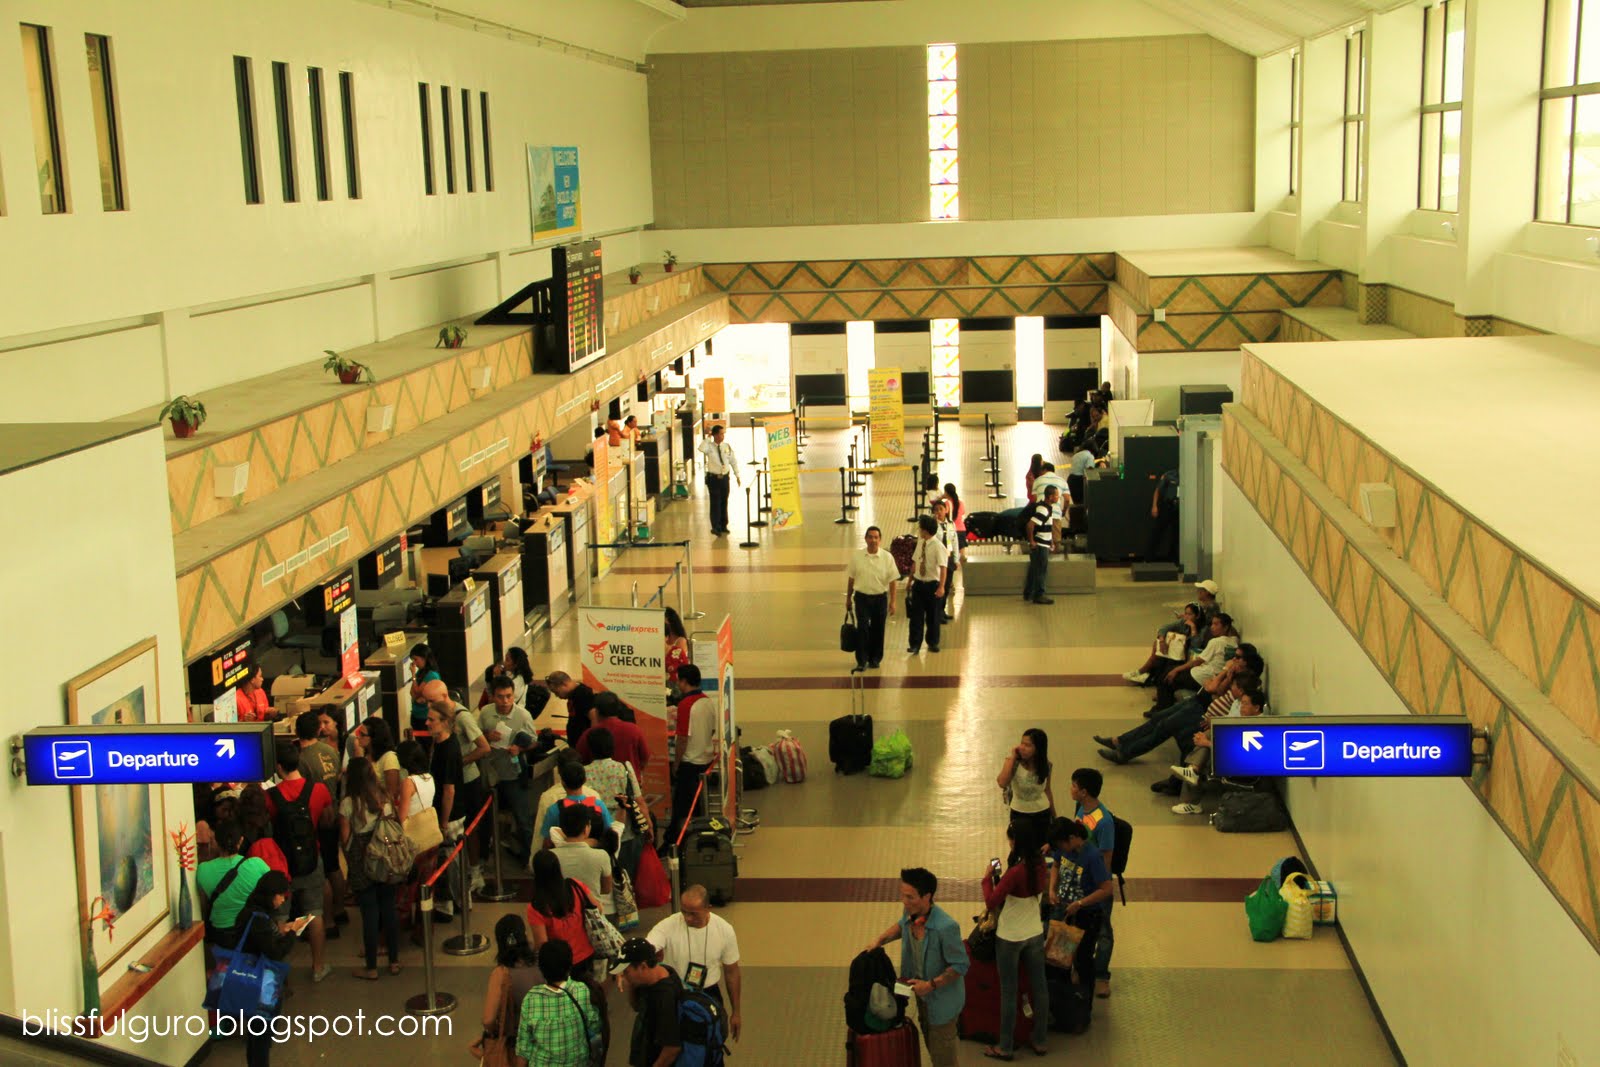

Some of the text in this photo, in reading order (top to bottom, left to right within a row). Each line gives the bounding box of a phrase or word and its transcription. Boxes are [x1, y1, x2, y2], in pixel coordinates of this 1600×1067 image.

[768, 427, 790, 443] WEB
[606, 624, 659, 634] airphilexpress
[609, 644, 634, 655] WEB
[609, 656, 661, 668] CHECK IN
[1342, 741, 1441, 762] Departure
[108, 750, 199, 770] Departure
